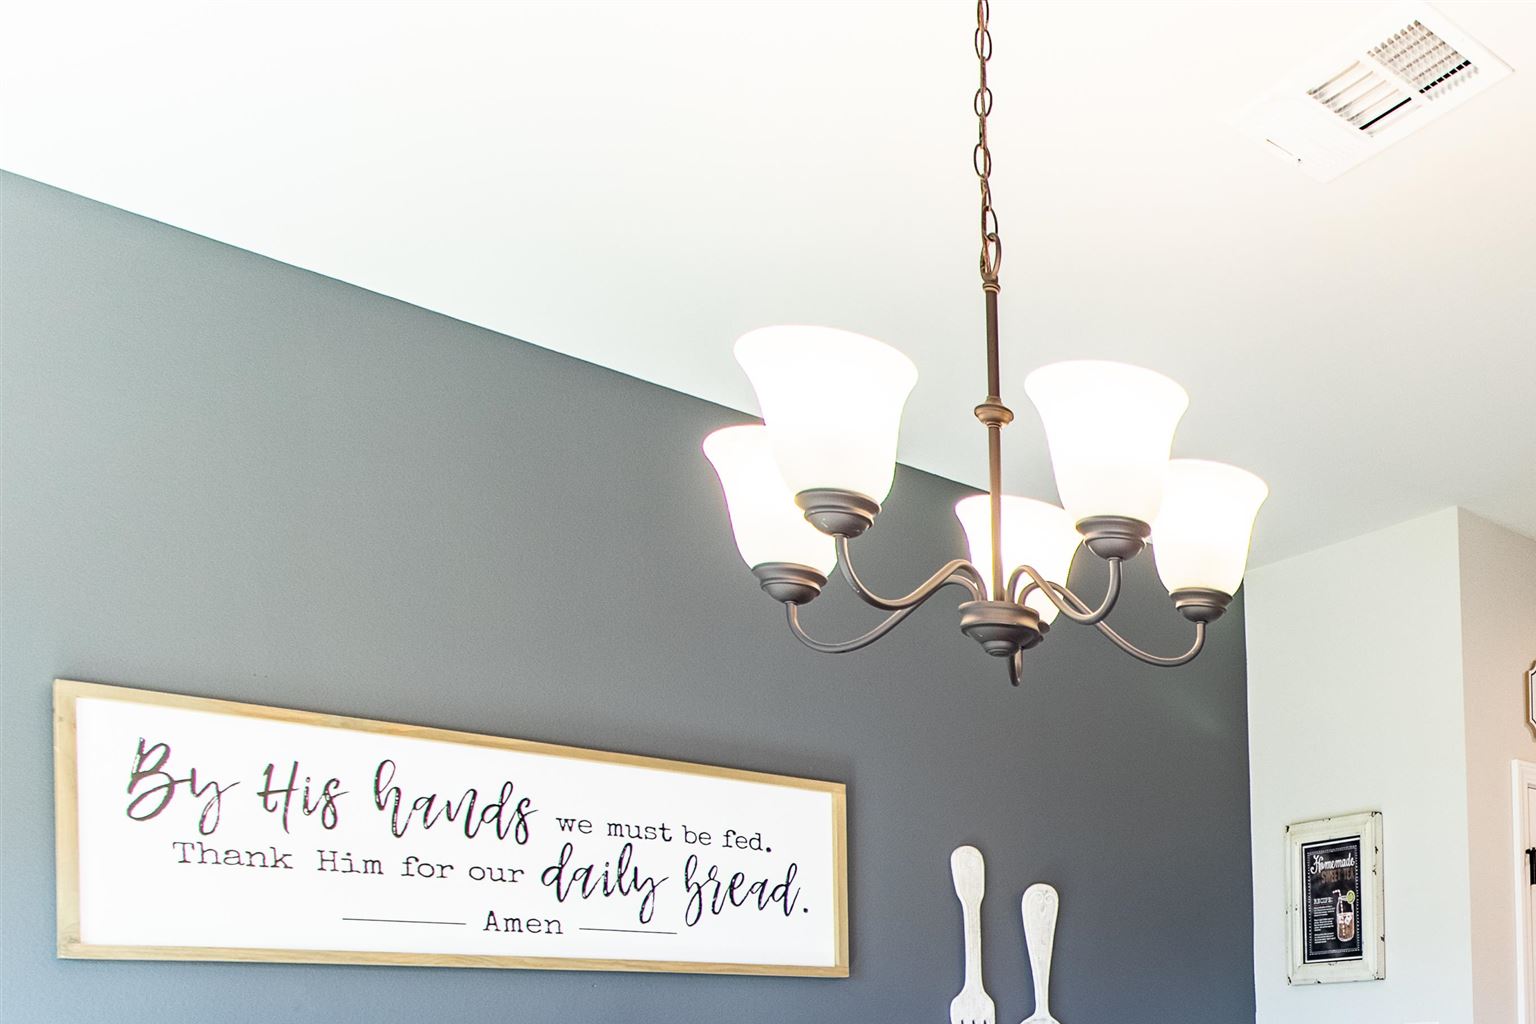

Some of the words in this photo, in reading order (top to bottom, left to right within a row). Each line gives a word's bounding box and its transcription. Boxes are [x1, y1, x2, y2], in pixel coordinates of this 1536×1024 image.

[126, 737, 241, 835] By
[256, 760, 350, 834] His
[373, 759, 539, 846] hands
[555, 816, 593, 834] we
[606, 821, 673, 842] must
[681, 824, 712, 846] be
[722, 829, 772, 853] fed.
[172, 841, 294, 870] Thank
[316, 849, 384, 875] Him
[400, 855, 454, 879] for
[468, 866, 525, 883] our
[541, 842, 670, 925] daily
[684, 854, 809, 928] bread.
[1310, 852, 1355, 874] Homemade
[482, 910, 564, 935] Amen
